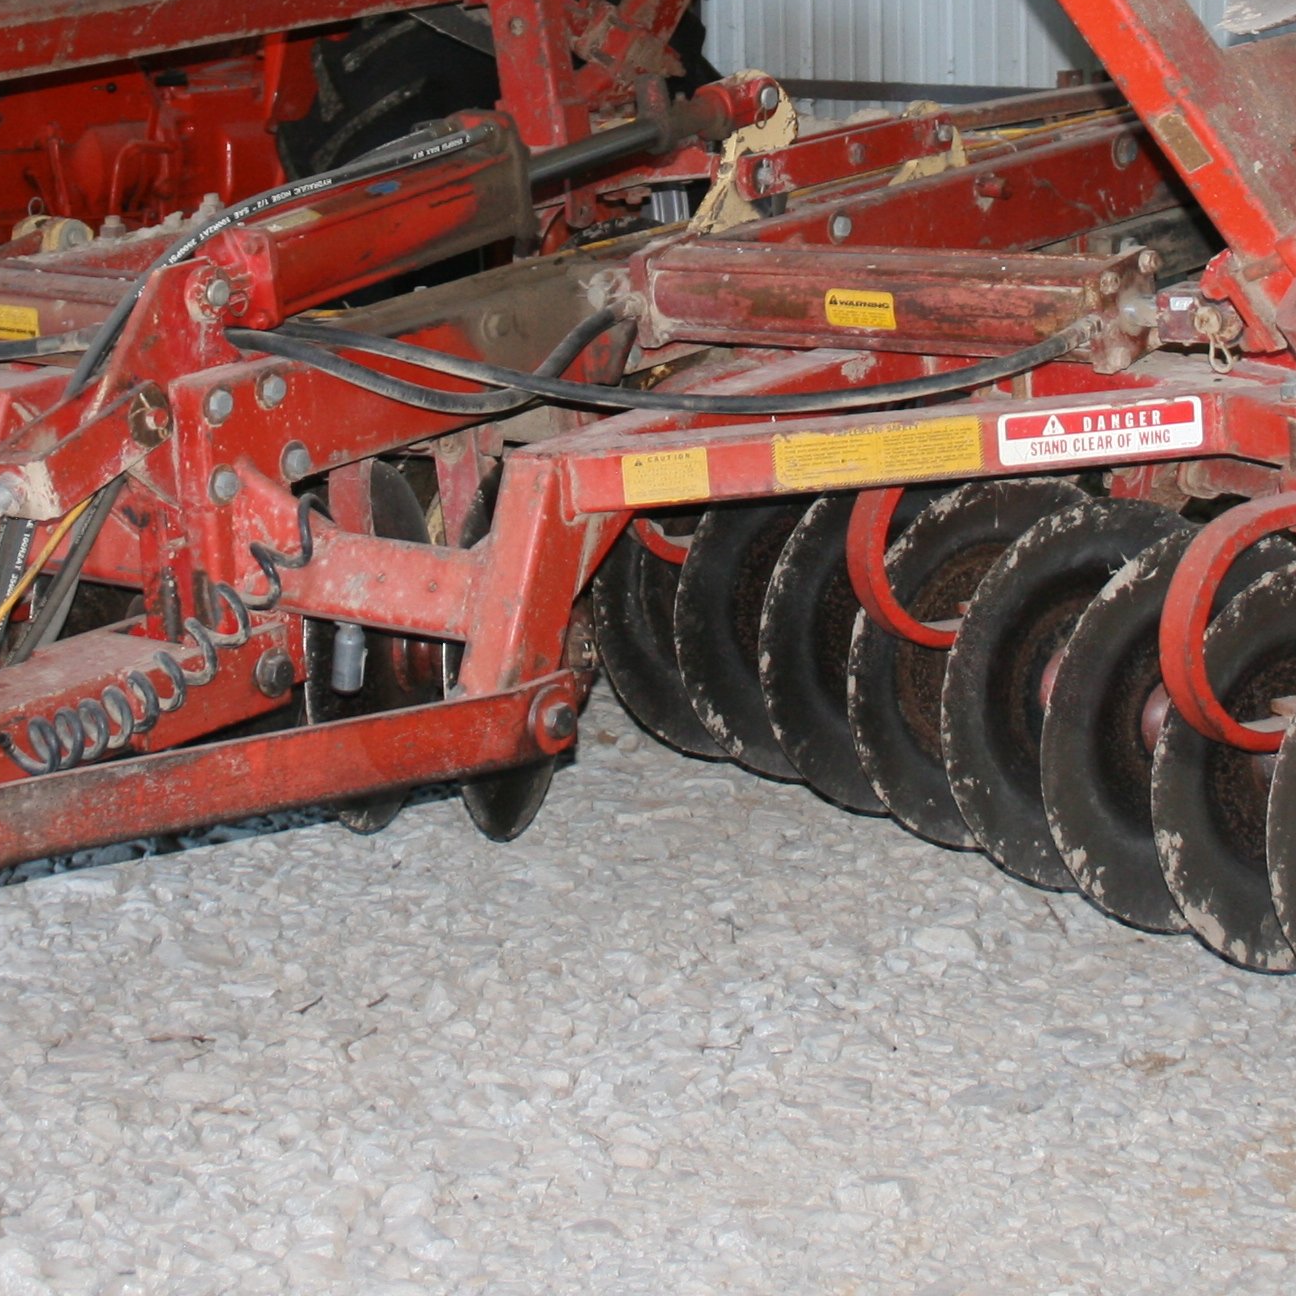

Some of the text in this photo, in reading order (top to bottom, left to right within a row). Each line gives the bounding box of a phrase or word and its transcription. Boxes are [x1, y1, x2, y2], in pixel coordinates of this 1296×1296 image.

[293, 178, 333, 194] HYDRAULIC
[271, 190, 292, 203] HOSE
[233, 206, 250, 219] SAE
[1083, 409, 1162, 433] DANGER
[1030, 429, 1171, 457] STAND CLEAR OF WING
[647, 453, 690, 463] CAUTION
